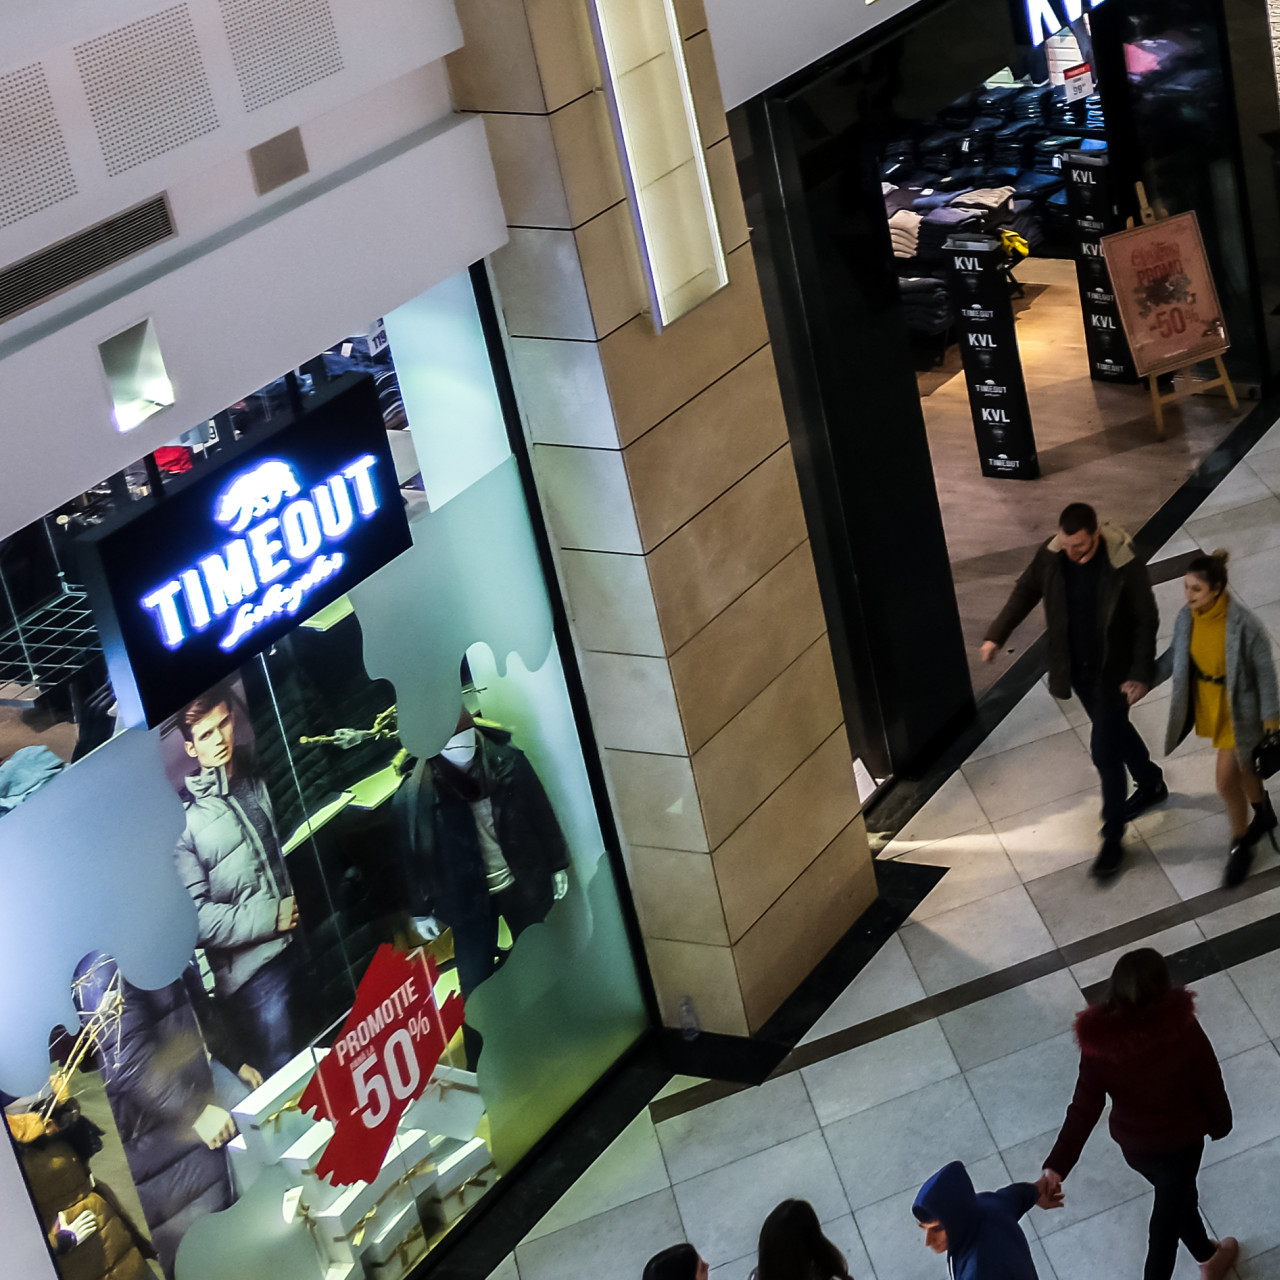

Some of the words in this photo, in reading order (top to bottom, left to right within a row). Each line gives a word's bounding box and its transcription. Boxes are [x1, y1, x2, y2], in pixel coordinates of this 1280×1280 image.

[1072, 169, 1097, 185] KVL
[954, 256, 984, 271] KVL
[961, 308, 994, 319] TIMEOUT
[1091, 314, 1117, 330] KVL
[968, 333, 998, 348] KVL
[975, 384, 1007, 394] TIMEOUT
[981, 408, 1011, 423] KVL
[988, 457, 1020, 468] TIMEOUT
[142, 454, 380, 647] TIMEOUT
